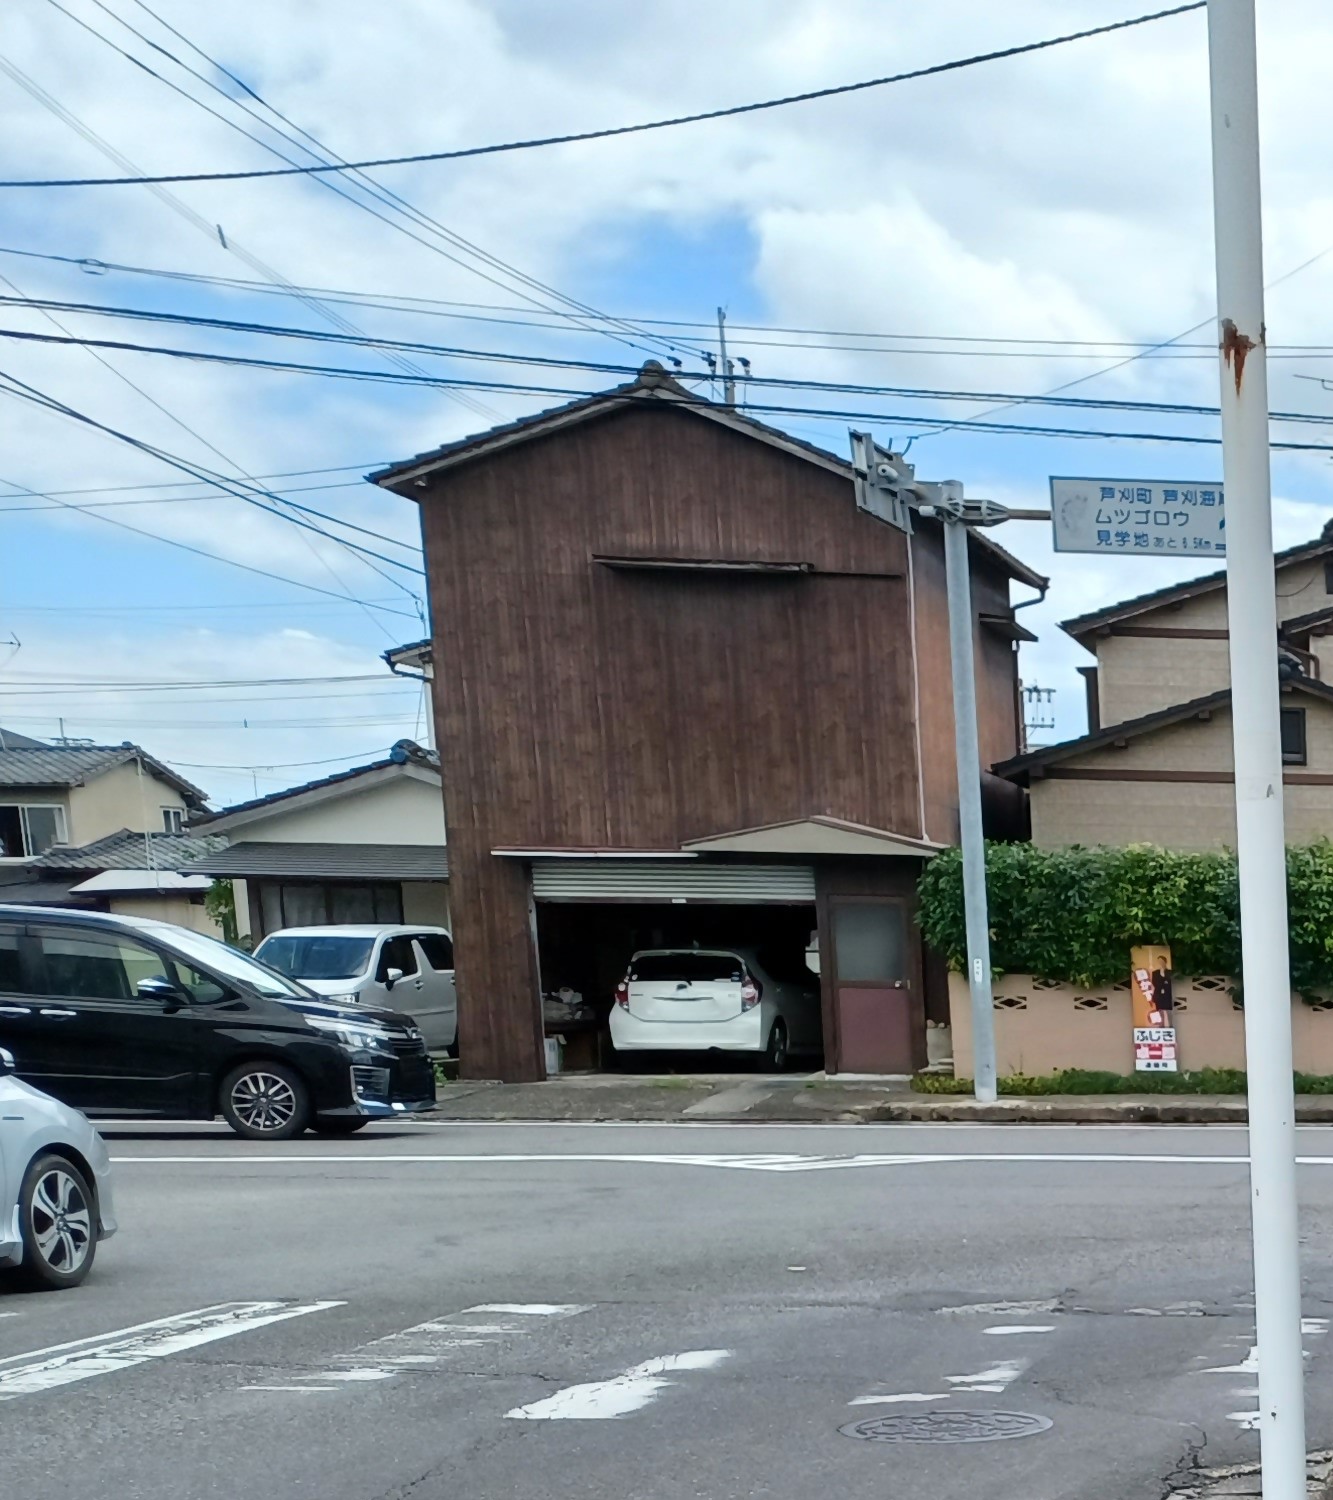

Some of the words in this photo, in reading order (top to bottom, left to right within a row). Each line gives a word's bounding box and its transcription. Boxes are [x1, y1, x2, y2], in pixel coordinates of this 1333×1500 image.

[1099, 486, 1152, 504] 芦刈町
[1095, 508, 1190, 526] ムツゴロウ
[1096, 529, 1149, 547] 見学地
